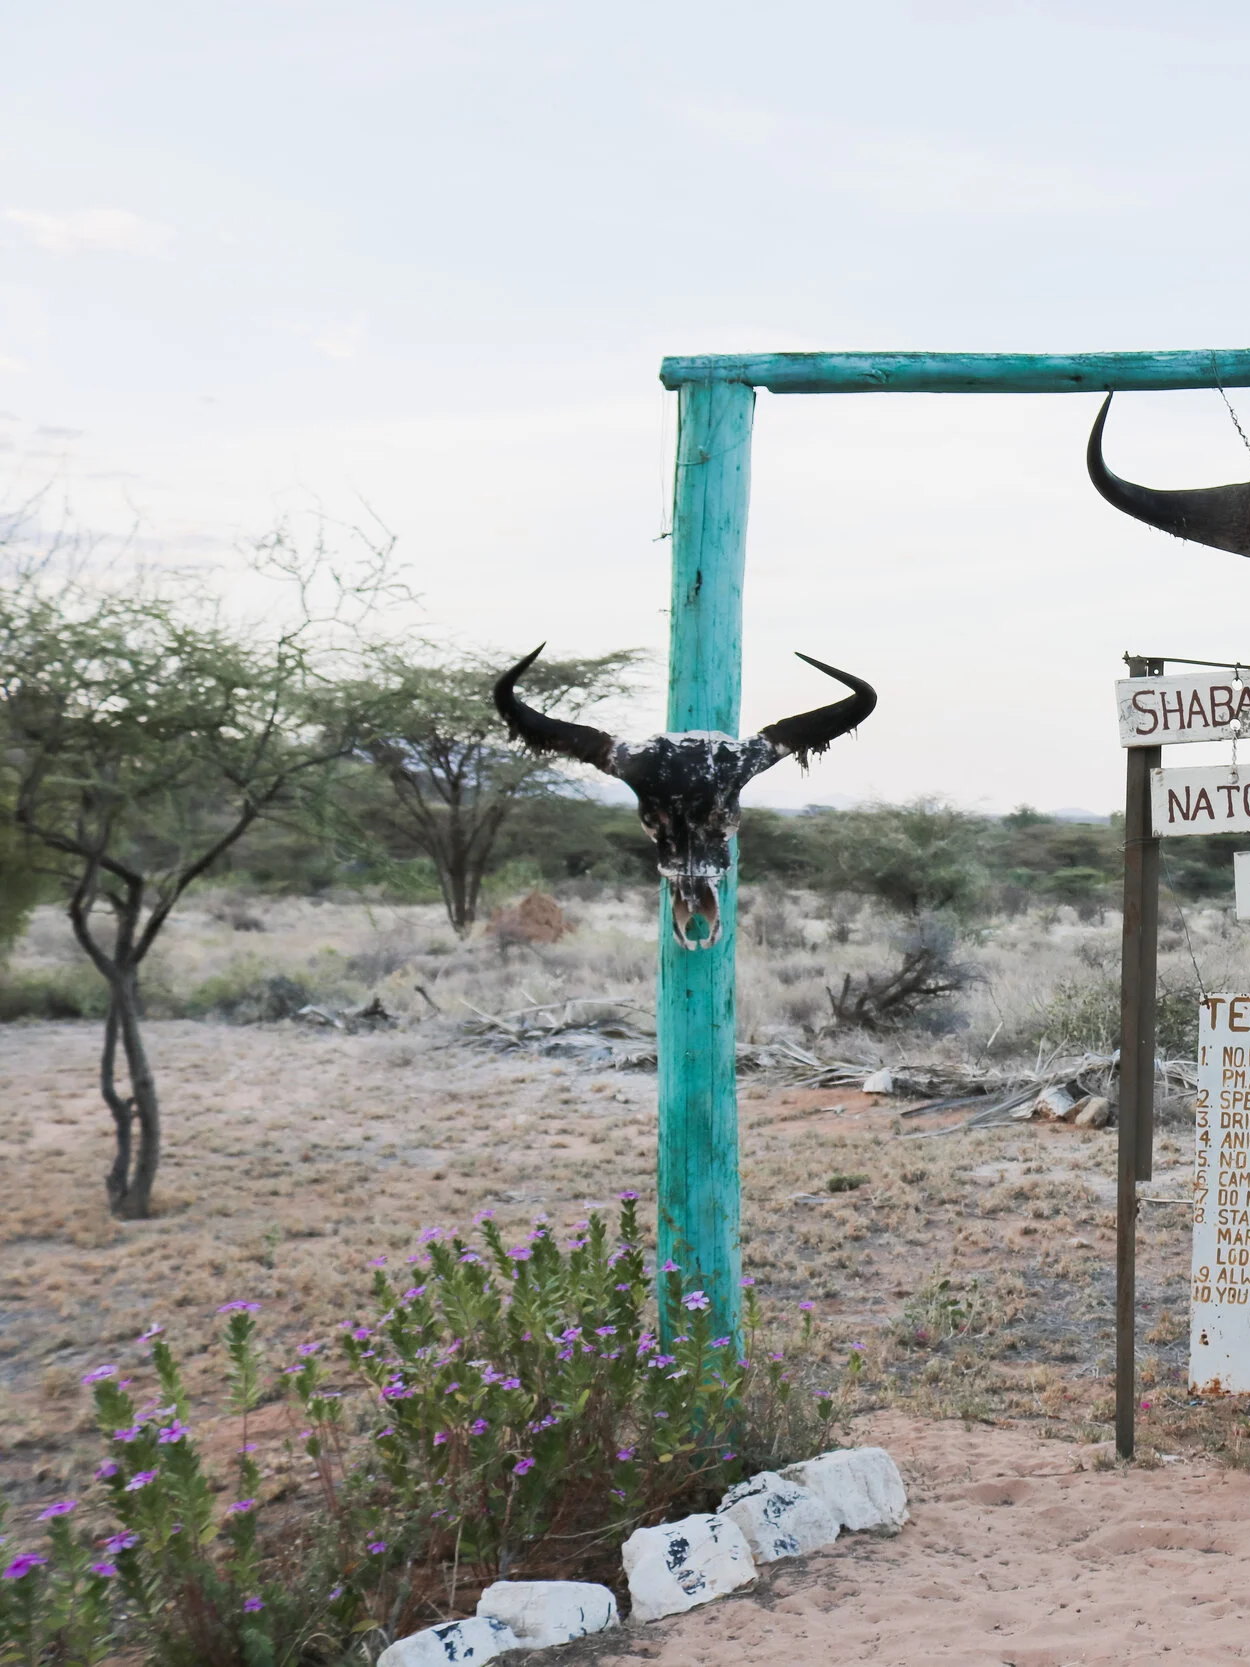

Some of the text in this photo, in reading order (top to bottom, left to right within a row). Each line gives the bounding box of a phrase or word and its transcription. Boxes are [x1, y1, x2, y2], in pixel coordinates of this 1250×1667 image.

[1219, 1150, 1248, 1170] NO
[1217, 1188, 1239, 1207] DO
[1215, 1286, 1249, 1306] YOU
